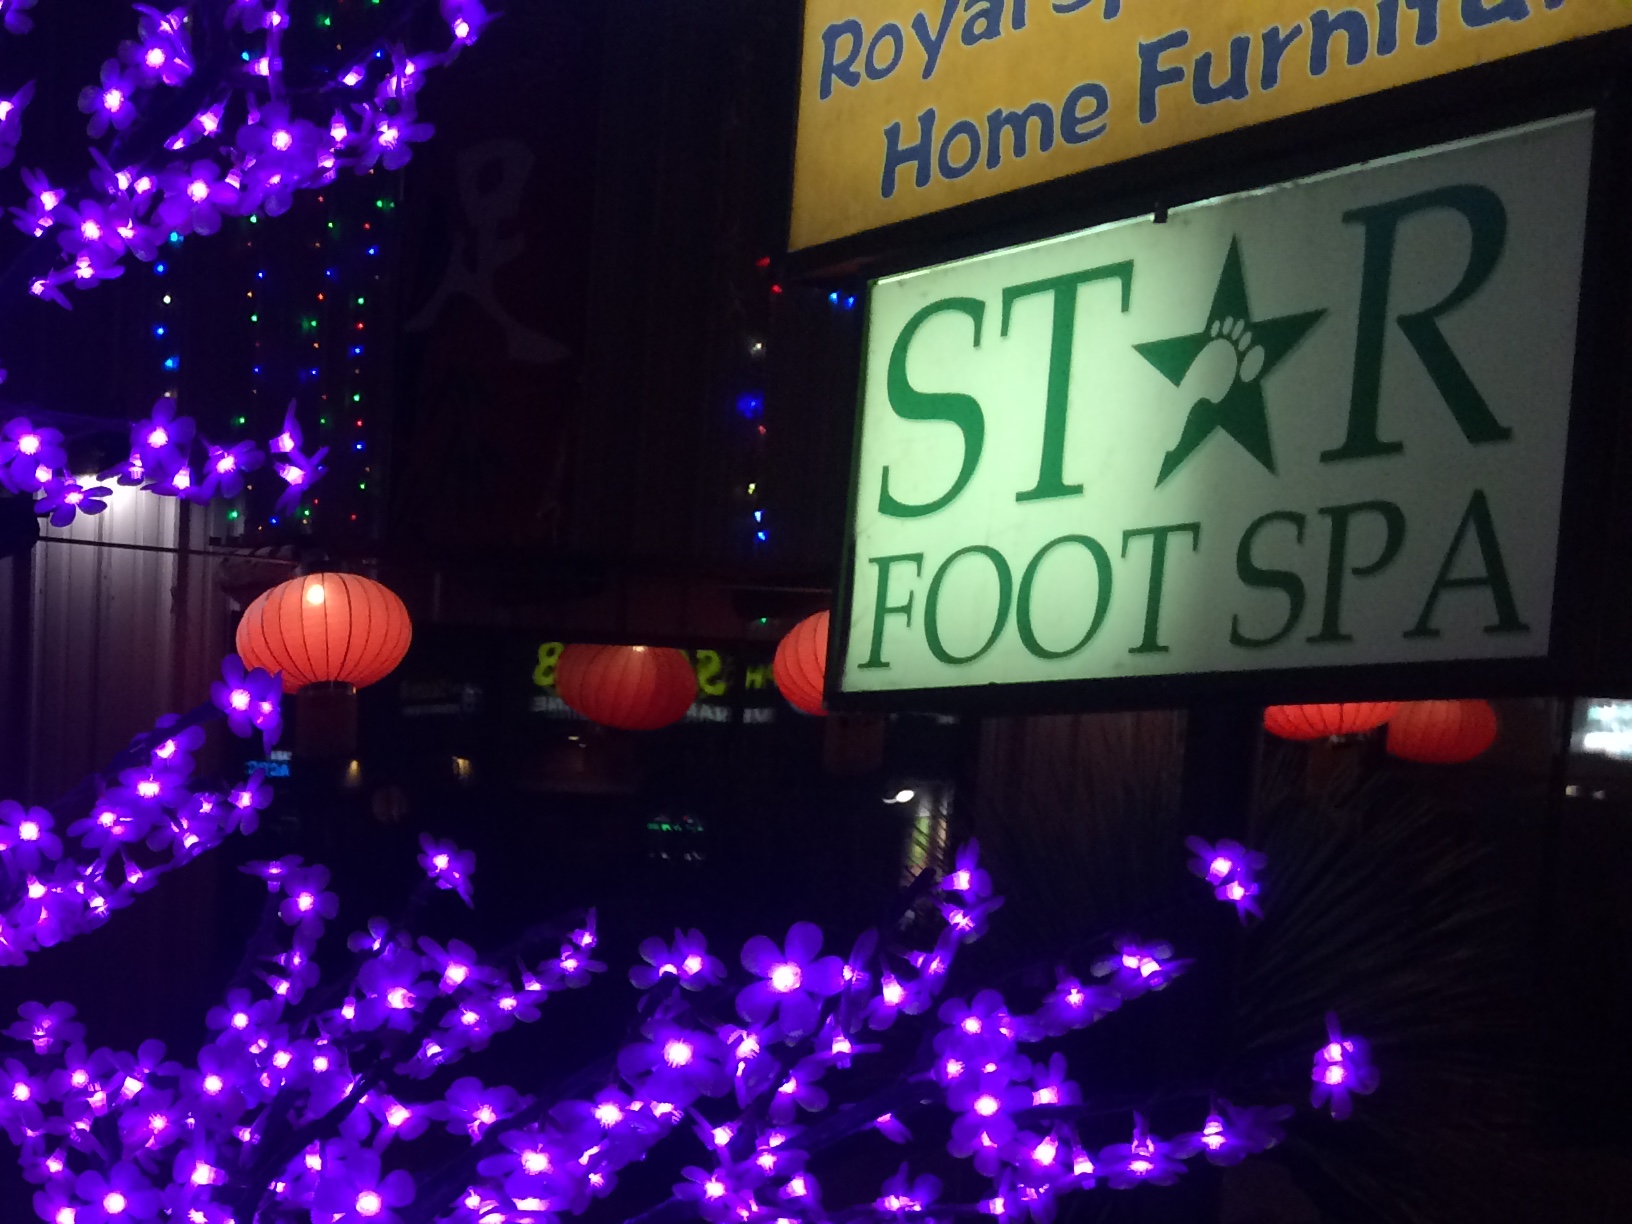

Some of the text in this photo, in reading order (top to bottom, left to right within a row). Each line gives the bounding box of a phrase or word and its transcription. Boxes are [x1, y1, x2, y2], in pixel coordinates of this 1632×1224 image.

[881, 0, 1565, 198] Home Furnitu
[857, 488, 1530, 670] FOOT SPA
